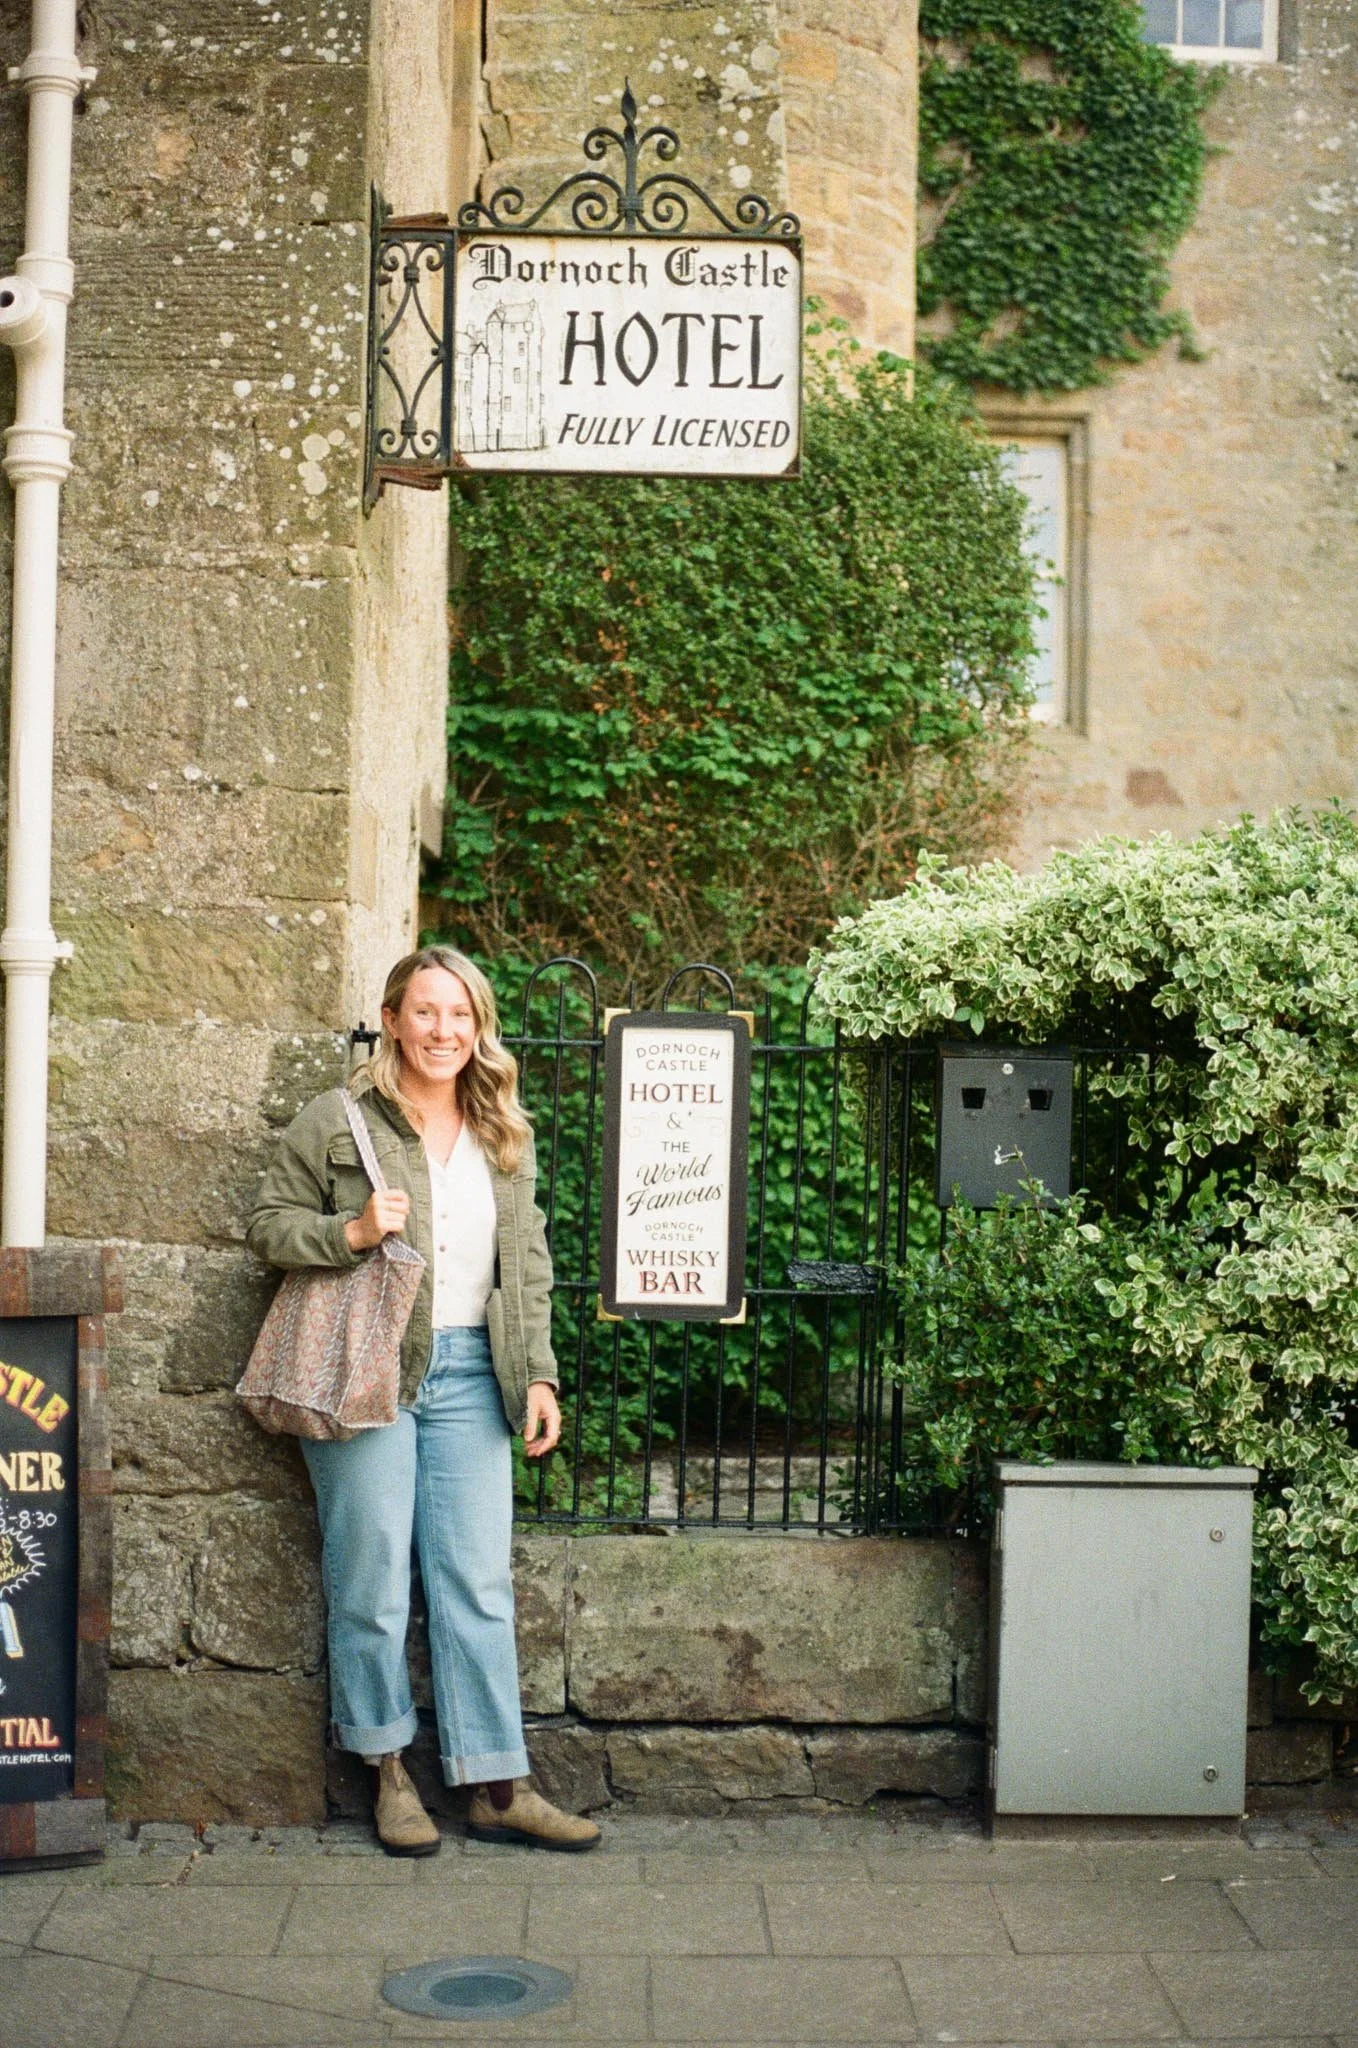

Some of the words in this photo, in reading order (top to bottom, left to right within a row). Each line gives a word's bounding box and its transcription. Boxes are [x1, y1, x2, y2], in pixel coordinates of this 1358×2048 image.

[469, 243, 647, 289] Dornoch
[665, 246, 791, 288] Castle
[559, 311, 784, 389] HOTEL
[558, 413, 645, 445] FULLY
[652, 414, 791, 449] LICENSED
[636, 1043, 721, 1060] DORNOCH
[646, 1059, 708, 1071] CASTLE
[629, 1082, 723, 1104] HOTEL
[666, 1112, 683, 1129] &
[661, 1141, 691, 1153] THE
[636, 1154, 713, 1186] World
[626, 1184, 723, 1216] Famous
[645, 1221, 704, 1233] DORNOCH
[651, 1232, 695, 1242] CASTLE
[626, 1249, 720, 1267] WHISKY
[639, 1270, 705, 1294] BAR
[0, 1717, 62, 1748] TIAL
